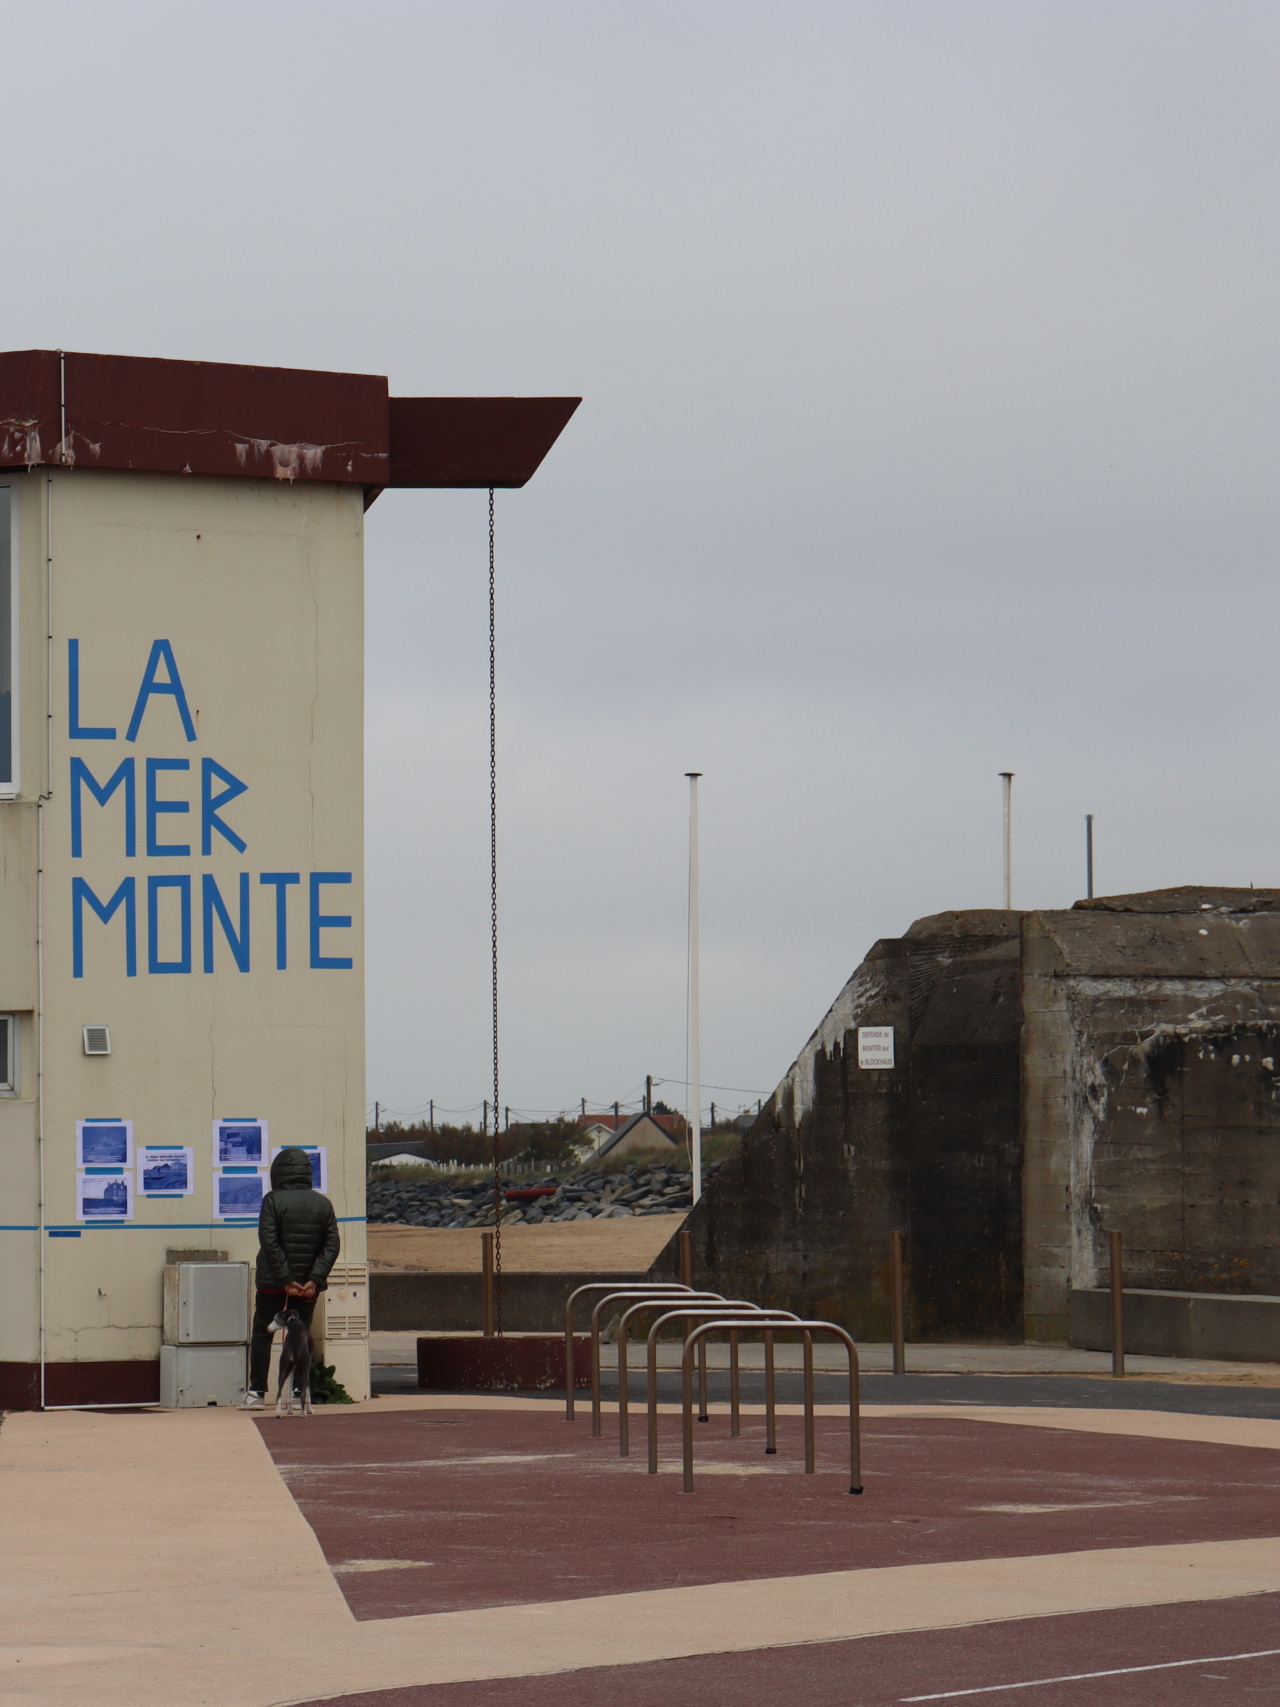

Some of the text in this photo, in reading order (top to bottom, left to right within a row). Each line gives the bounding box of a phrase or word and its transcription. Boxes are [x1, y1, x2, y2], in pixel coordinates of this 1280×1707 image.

[68, 638, 197, 742] LA
[70, 756, 249, 858] MER
[71, 871, 353, 979] MONTE
